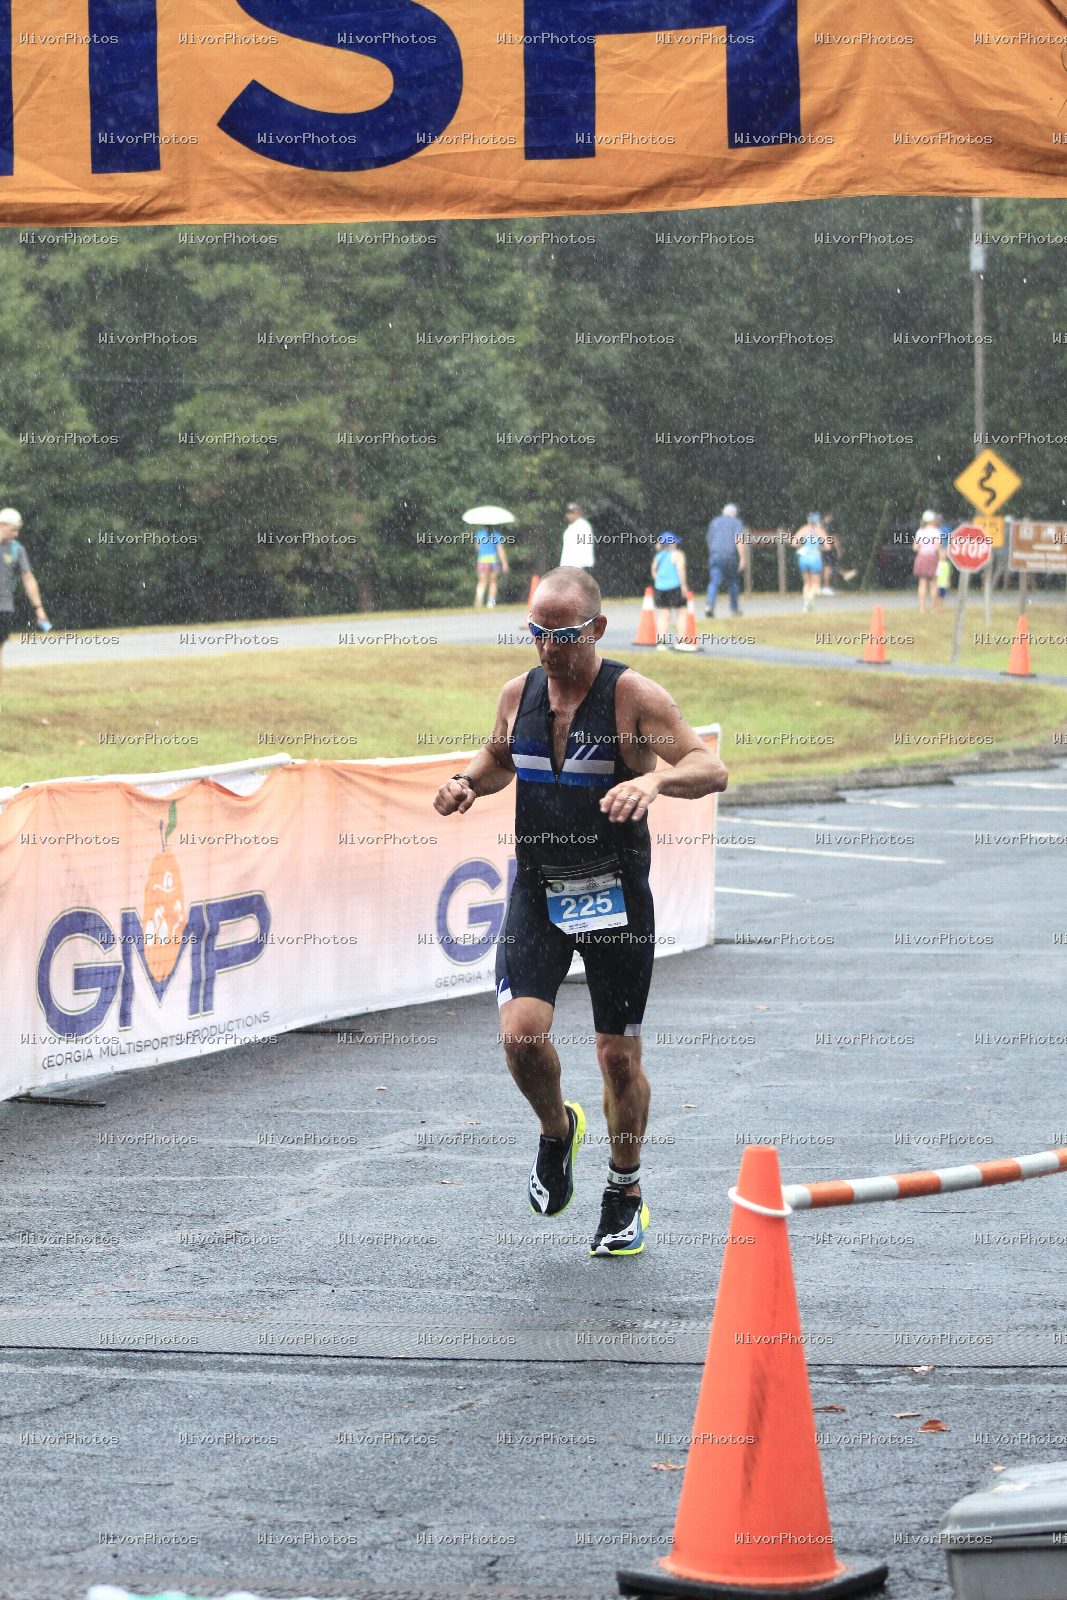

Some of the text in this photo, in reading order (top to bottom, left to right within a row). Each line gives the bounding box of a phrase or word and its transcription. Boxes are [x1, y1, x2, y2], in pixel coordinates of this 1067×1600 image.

[950, 540, 990, 558] STOP
[436, 856, 518, 966] G
[560, 890, 613, 920] 225
[36, 889, 271, 1041] GMP
[435, 971, 482, 988] GEORGIA
[99, 1033, 182, 1058] MULTISPORTS
